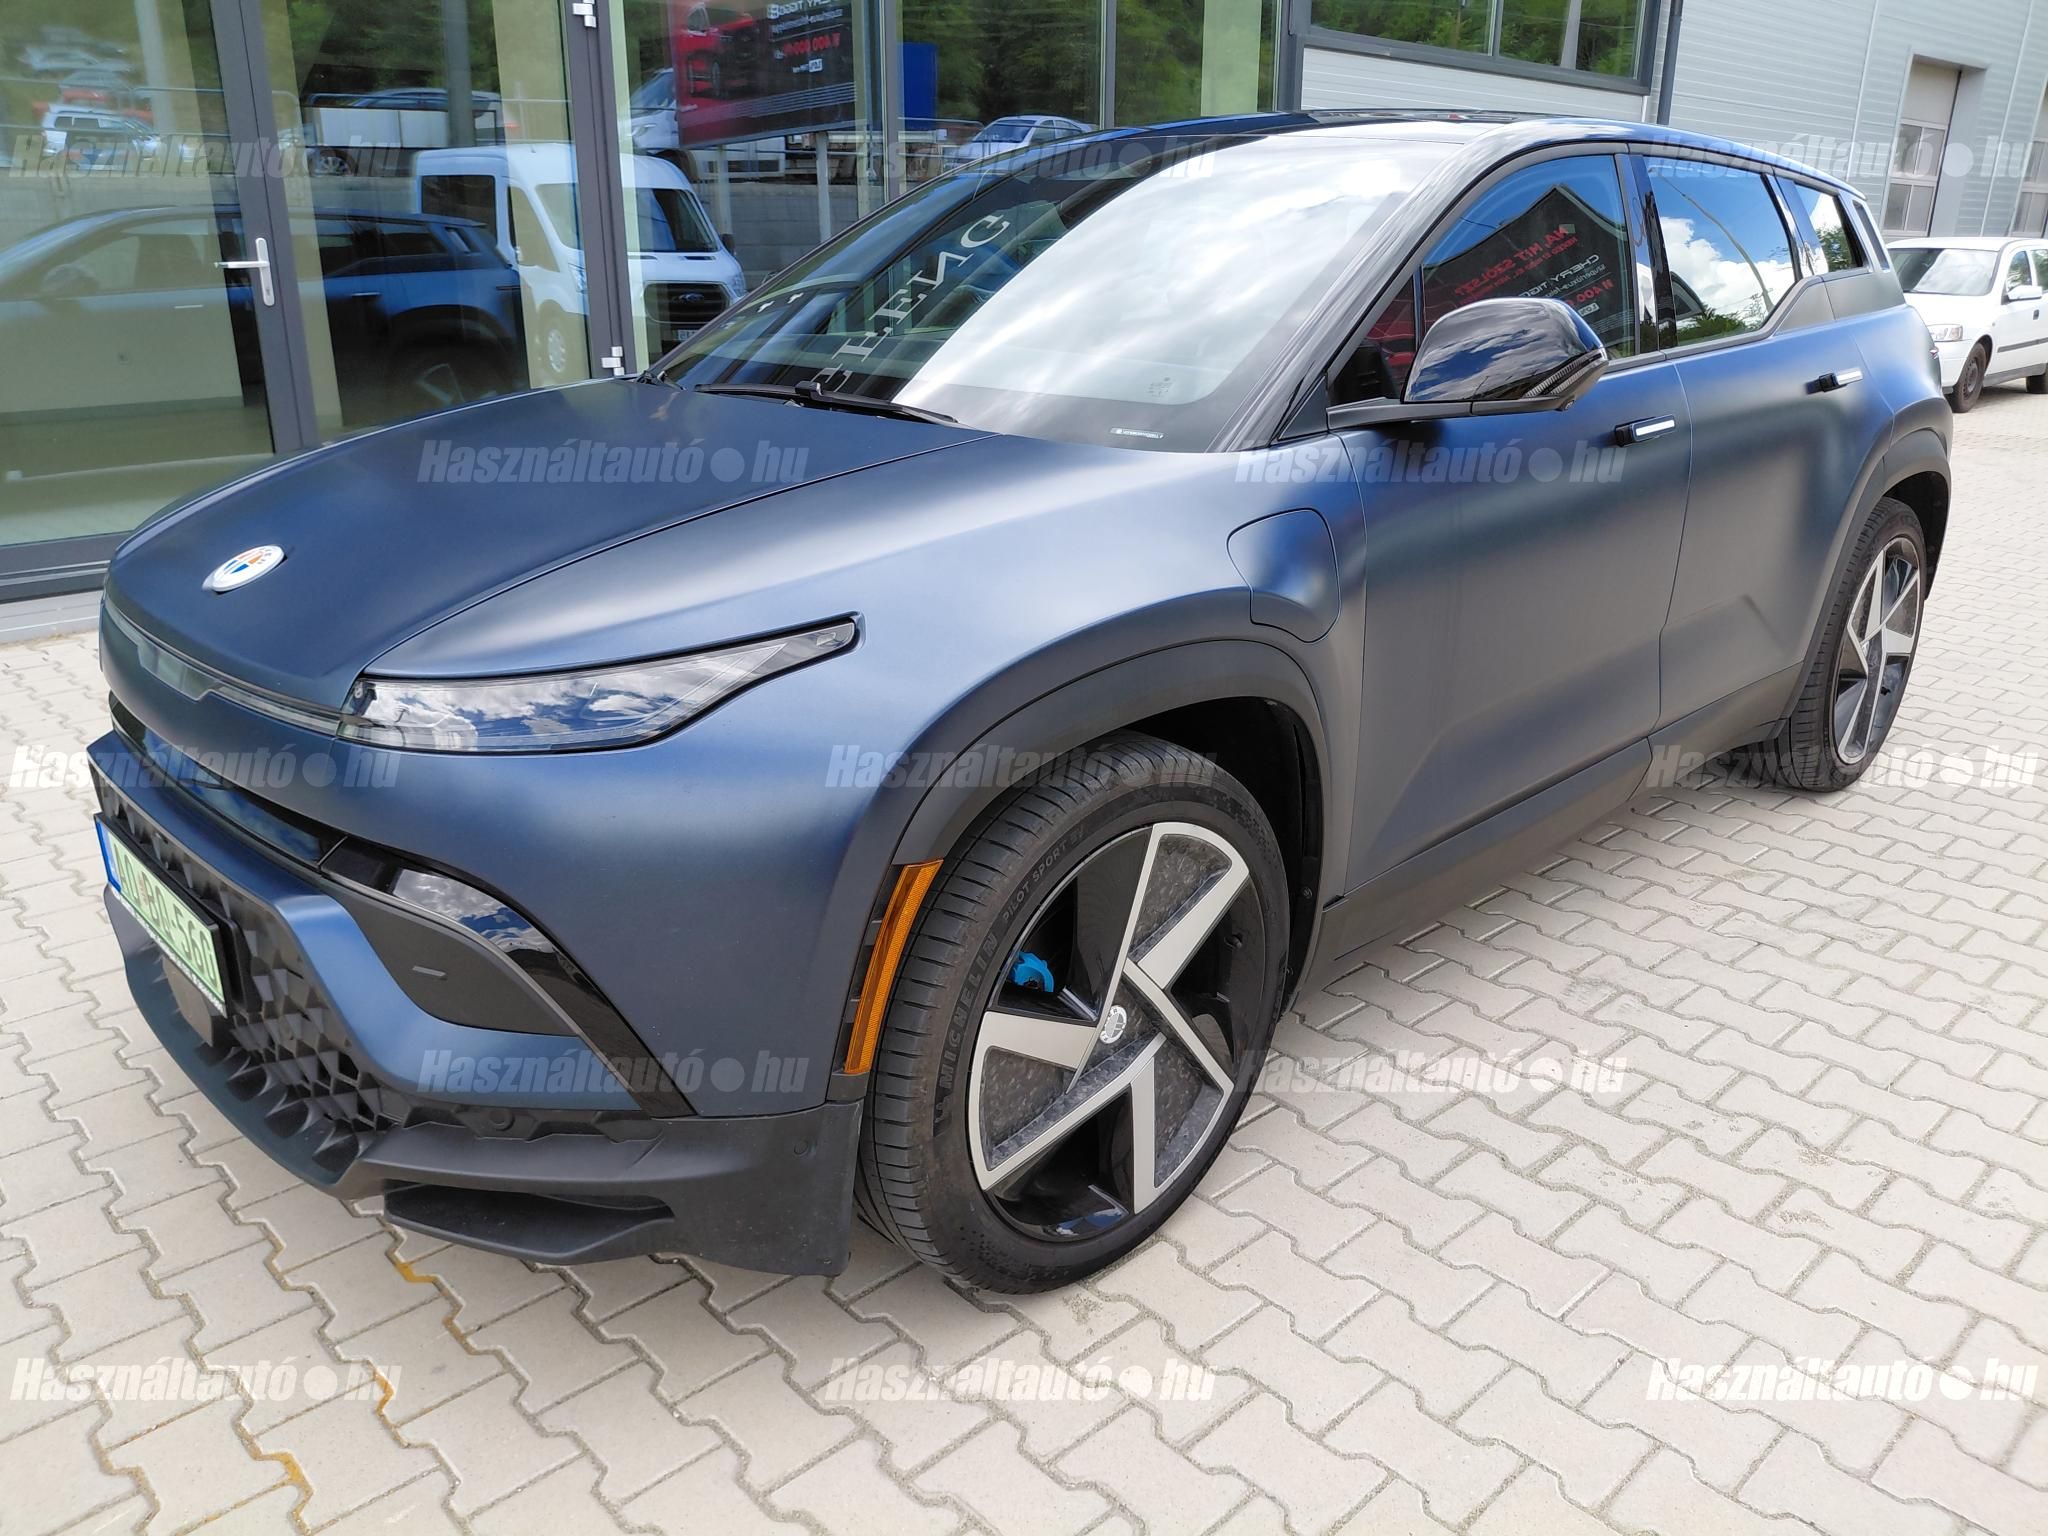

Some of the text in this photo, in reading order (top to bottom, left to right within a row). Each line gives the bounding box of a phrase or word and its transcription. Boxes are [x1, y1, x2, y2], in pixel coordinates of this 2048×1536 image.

[939, 934, 999, 1090] MICHELIN
[1002, 880, 1030, 922] PILOT
[1032, 843, 1068, 883] SPORT
